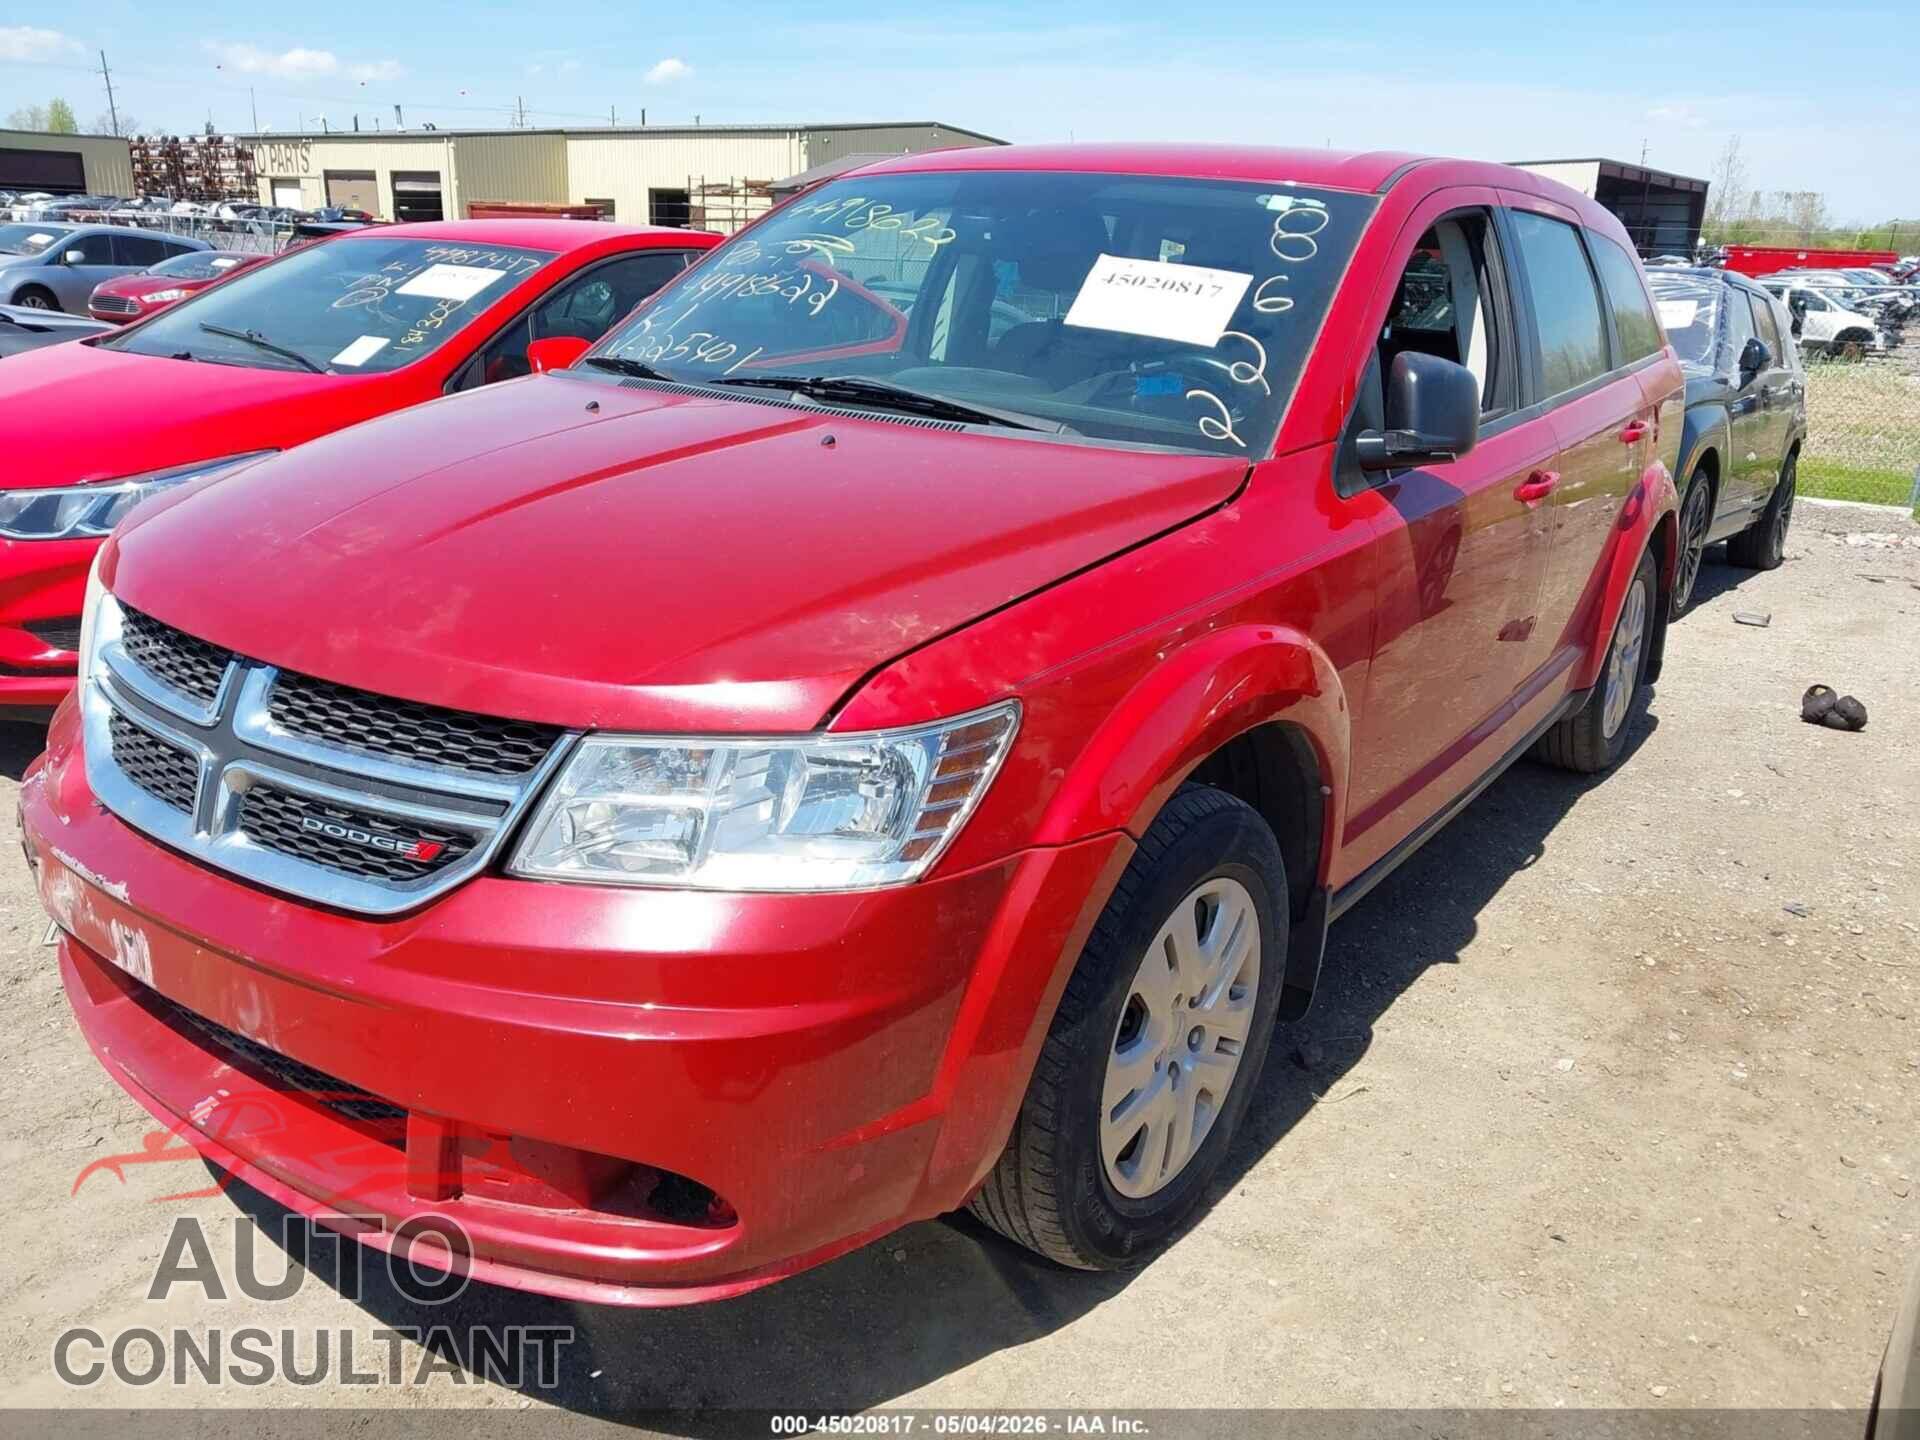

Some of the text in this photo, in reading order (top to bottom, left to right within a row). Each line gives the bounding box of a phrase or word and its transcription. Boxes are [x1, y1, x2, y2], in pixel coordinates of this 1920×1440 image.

[269, 142, 311, 174] PARTS
[1102, 271, 1225, 298] 45020817
[302, 816, 420, 856] DODGE
